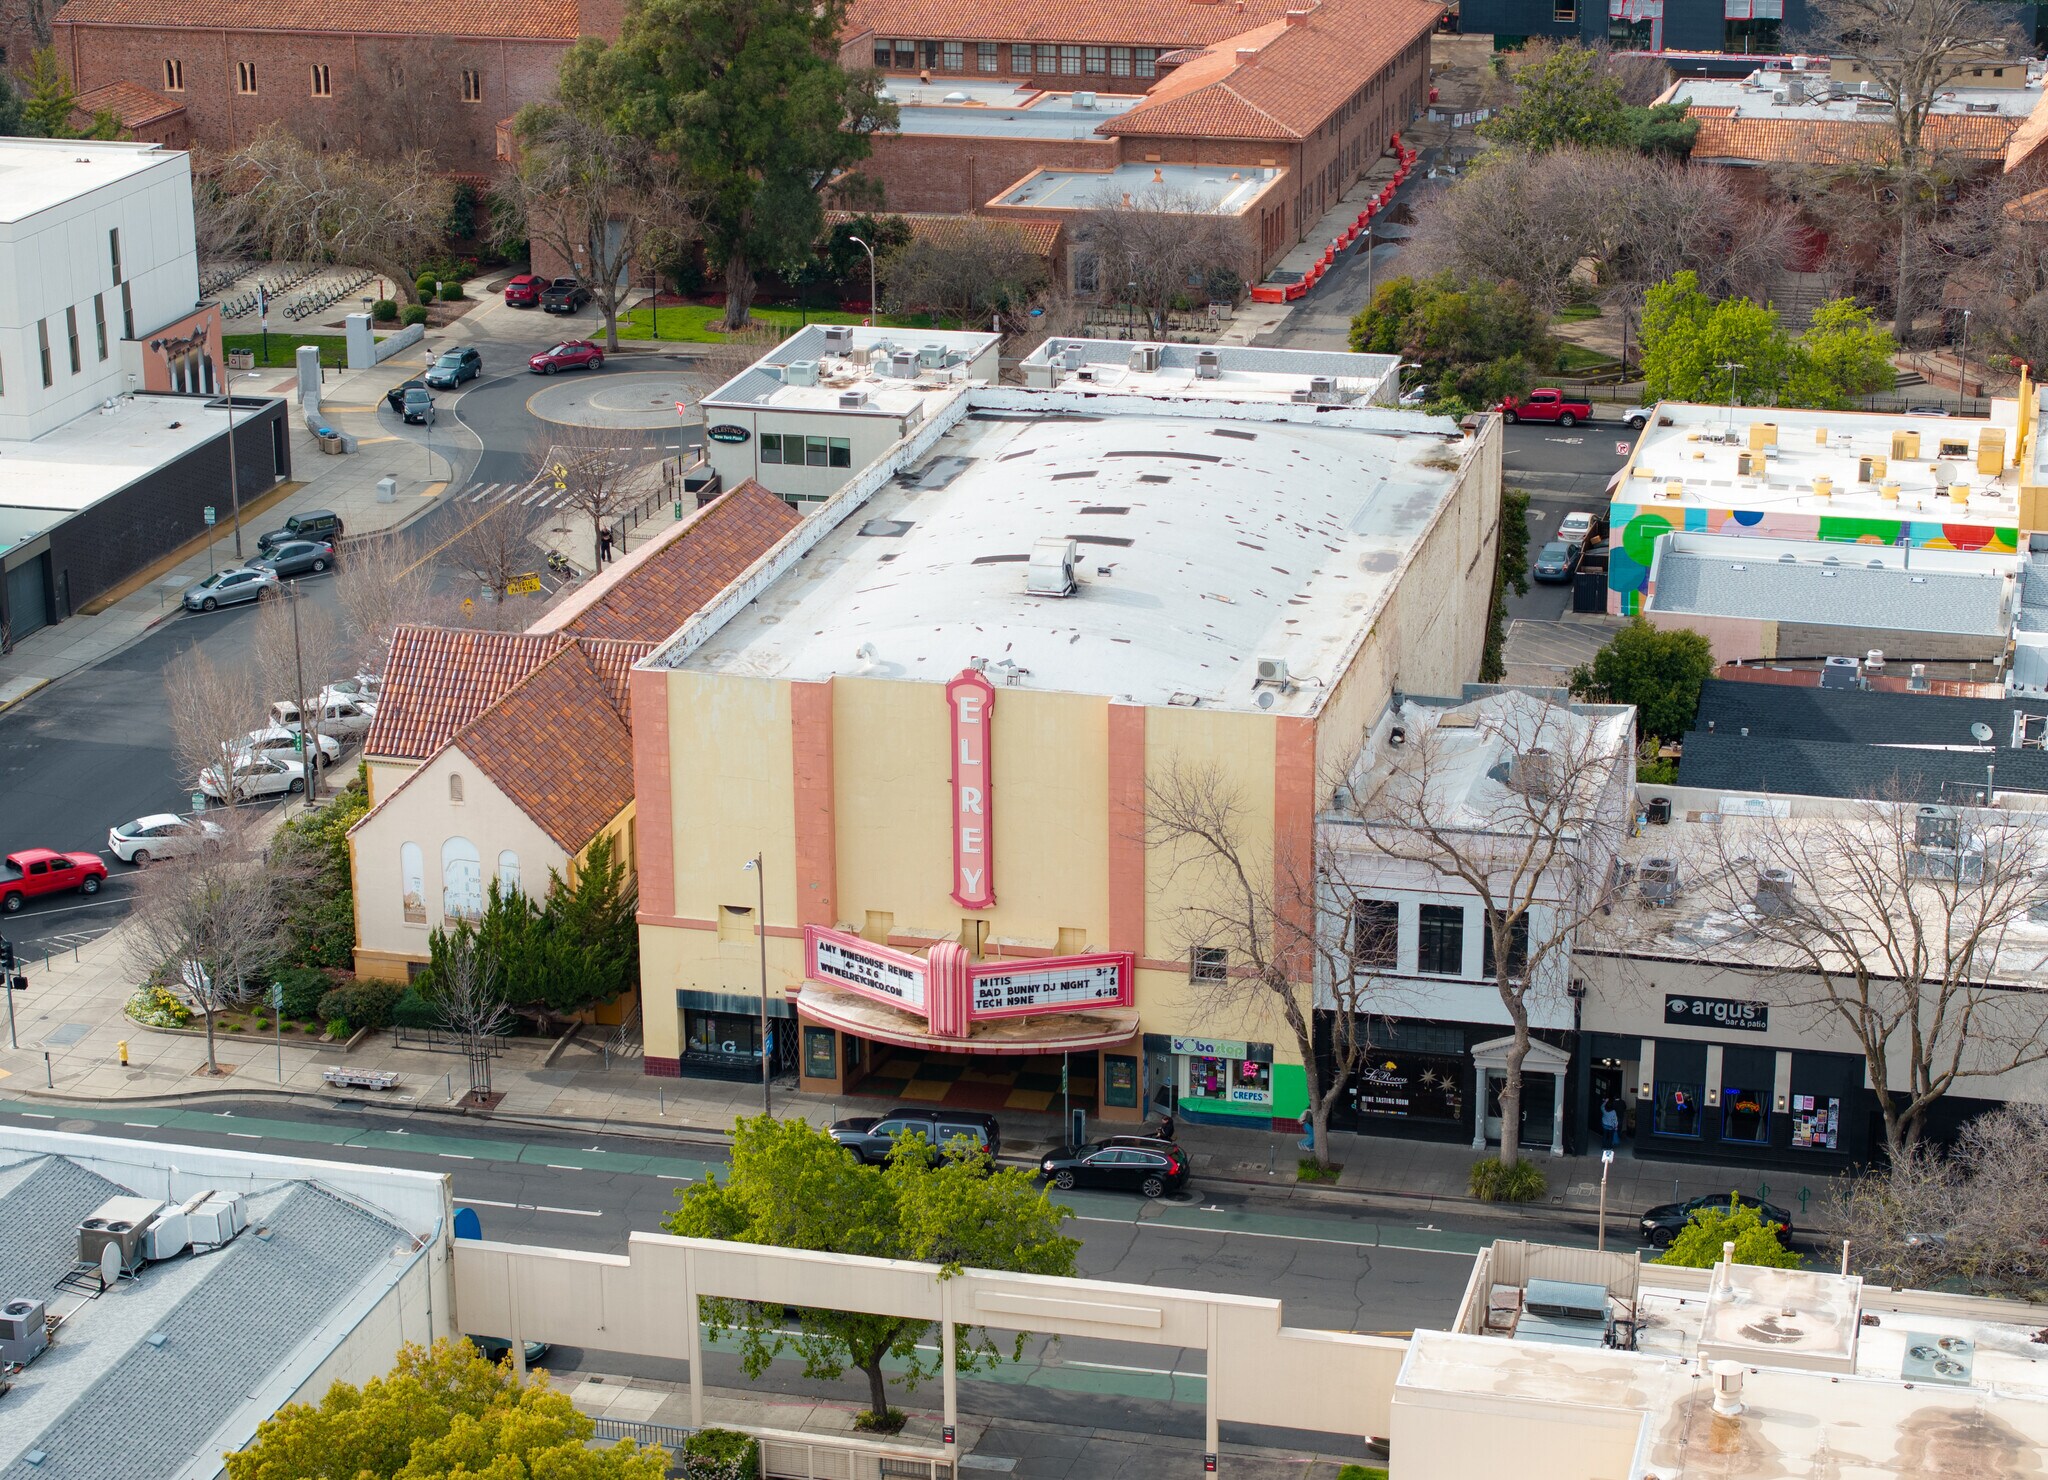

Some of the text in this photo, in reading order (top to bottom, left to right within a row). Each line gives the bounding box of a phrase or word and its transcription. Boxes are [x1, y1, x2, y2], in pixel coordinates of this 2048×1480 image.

[819, 942, 914, 980] AMY WINEHOUSE REVUE
[866, 967, 872, 976] &
[873, 970, 879, 978] 6
[820, 962, 903, 997] WWW.ELREYCHICO.COM
[980, 977, 1011, 987] MITIS
[980, 977, 1116, 998] BAD BUNNY DJ NIGHT 8
[976, 999, 1002, 1008] TECH
[1007, 996, 1034, 1006] N9NE
[1691, 1000, 1755, 1021] argus
[1740, 1019, 1746, 1027] &
[1747, 1020, 1767, 1028] patio
[722, 1040, 736, 1054] G
[1174, 1038, 1244, 1057] boba stop
[1379, 1070, 1408, 1082] Rocca
[1233, 1091, 1263, 1101] CREPES
